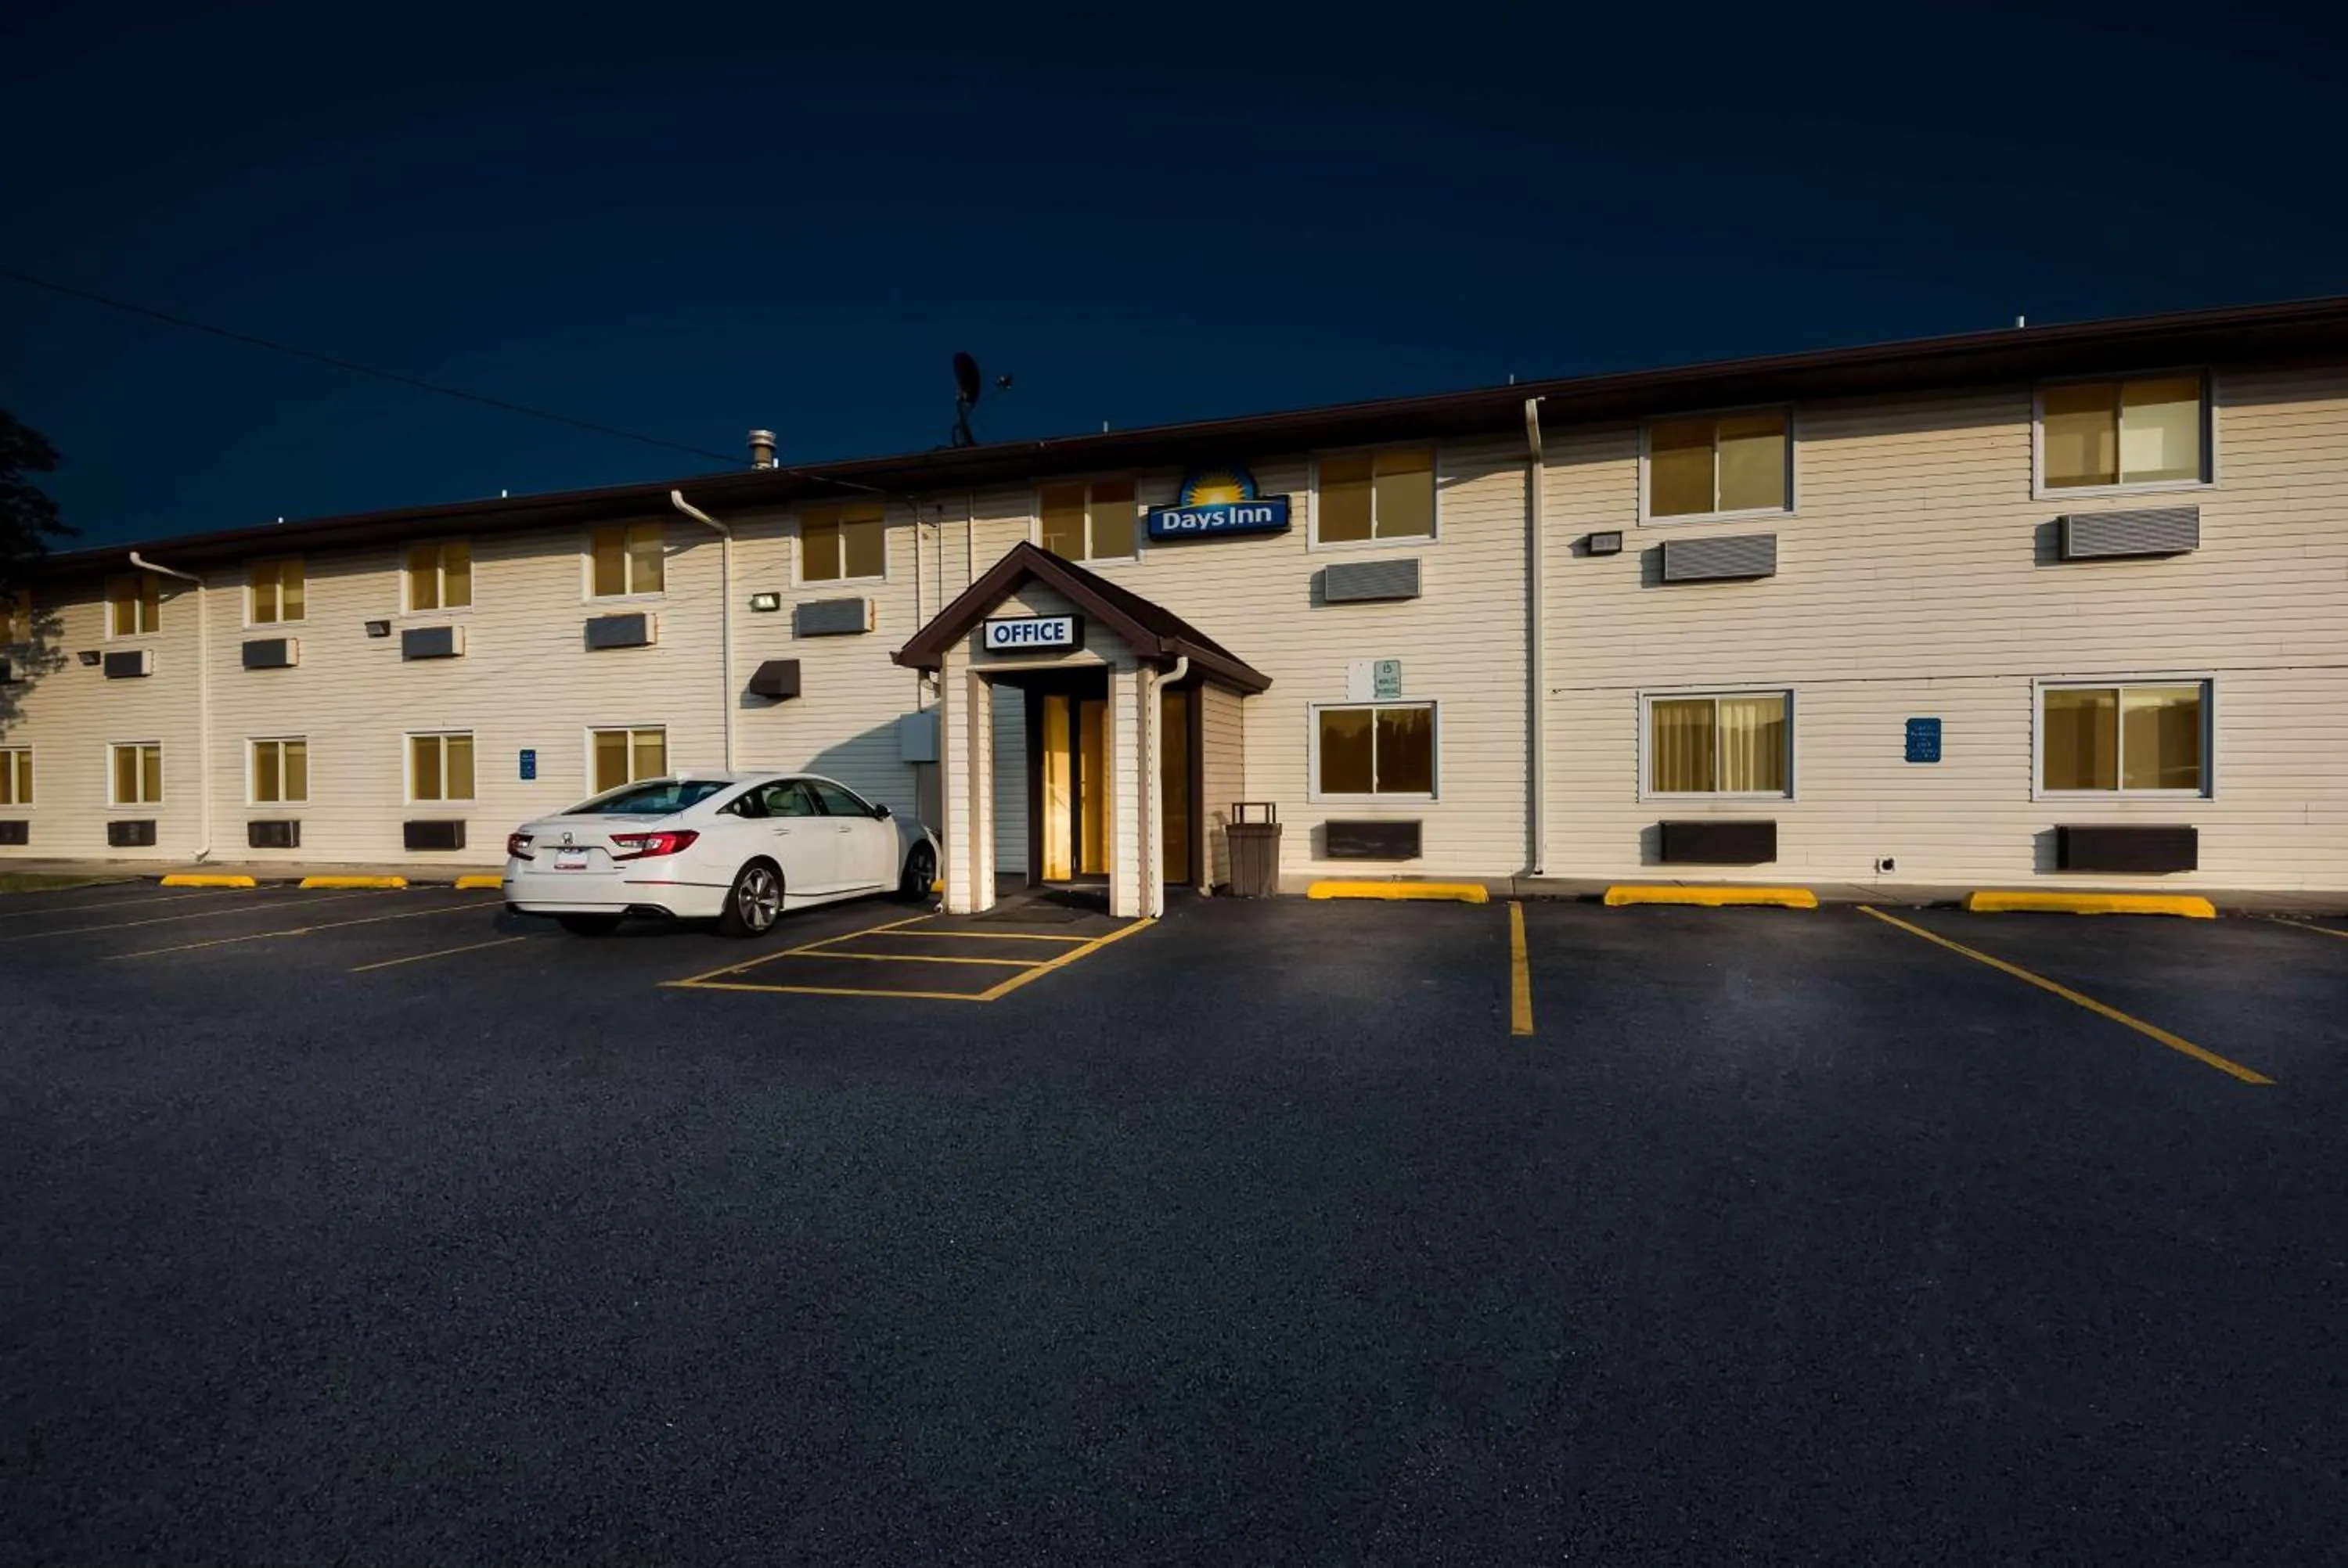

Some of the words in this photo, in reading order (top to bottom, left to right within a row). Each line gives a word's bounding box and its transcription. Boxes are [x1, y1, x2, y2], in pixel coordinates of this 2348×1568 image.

[1162, 511, 1225, 530] Days
[1230, 507, 1272, 524] Inn
[994, 622, 1064, 643] OFFICE
